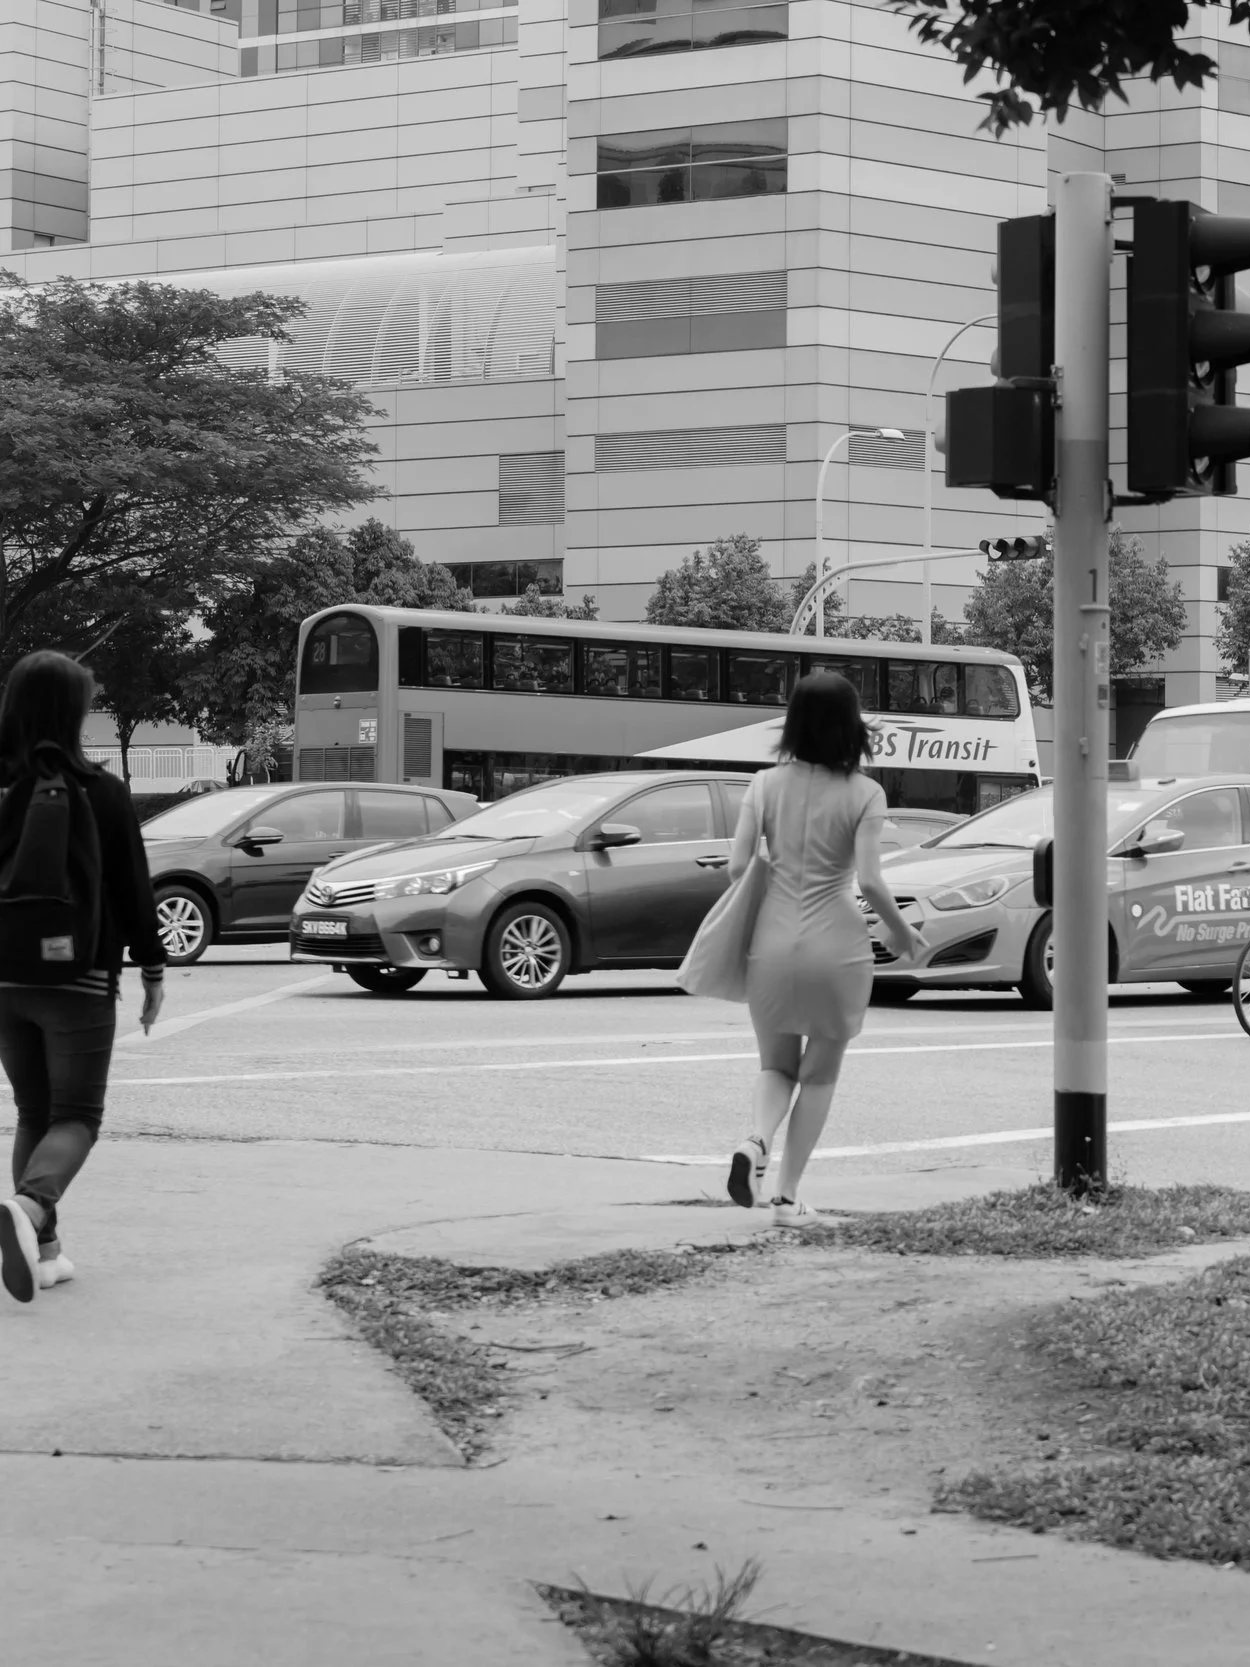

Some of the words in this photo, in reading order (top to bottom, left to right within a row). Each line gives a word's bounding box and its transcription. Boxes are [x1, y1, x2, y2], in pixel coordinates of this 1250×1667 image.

[1088, 568, 1097, 602] 1
[895, 726, 999, 763] Transit
[1174, 884, 1215, 913] Flat
[1176, 922, 1195, 943] No
[1199, 922, 1235, 944] Surge
